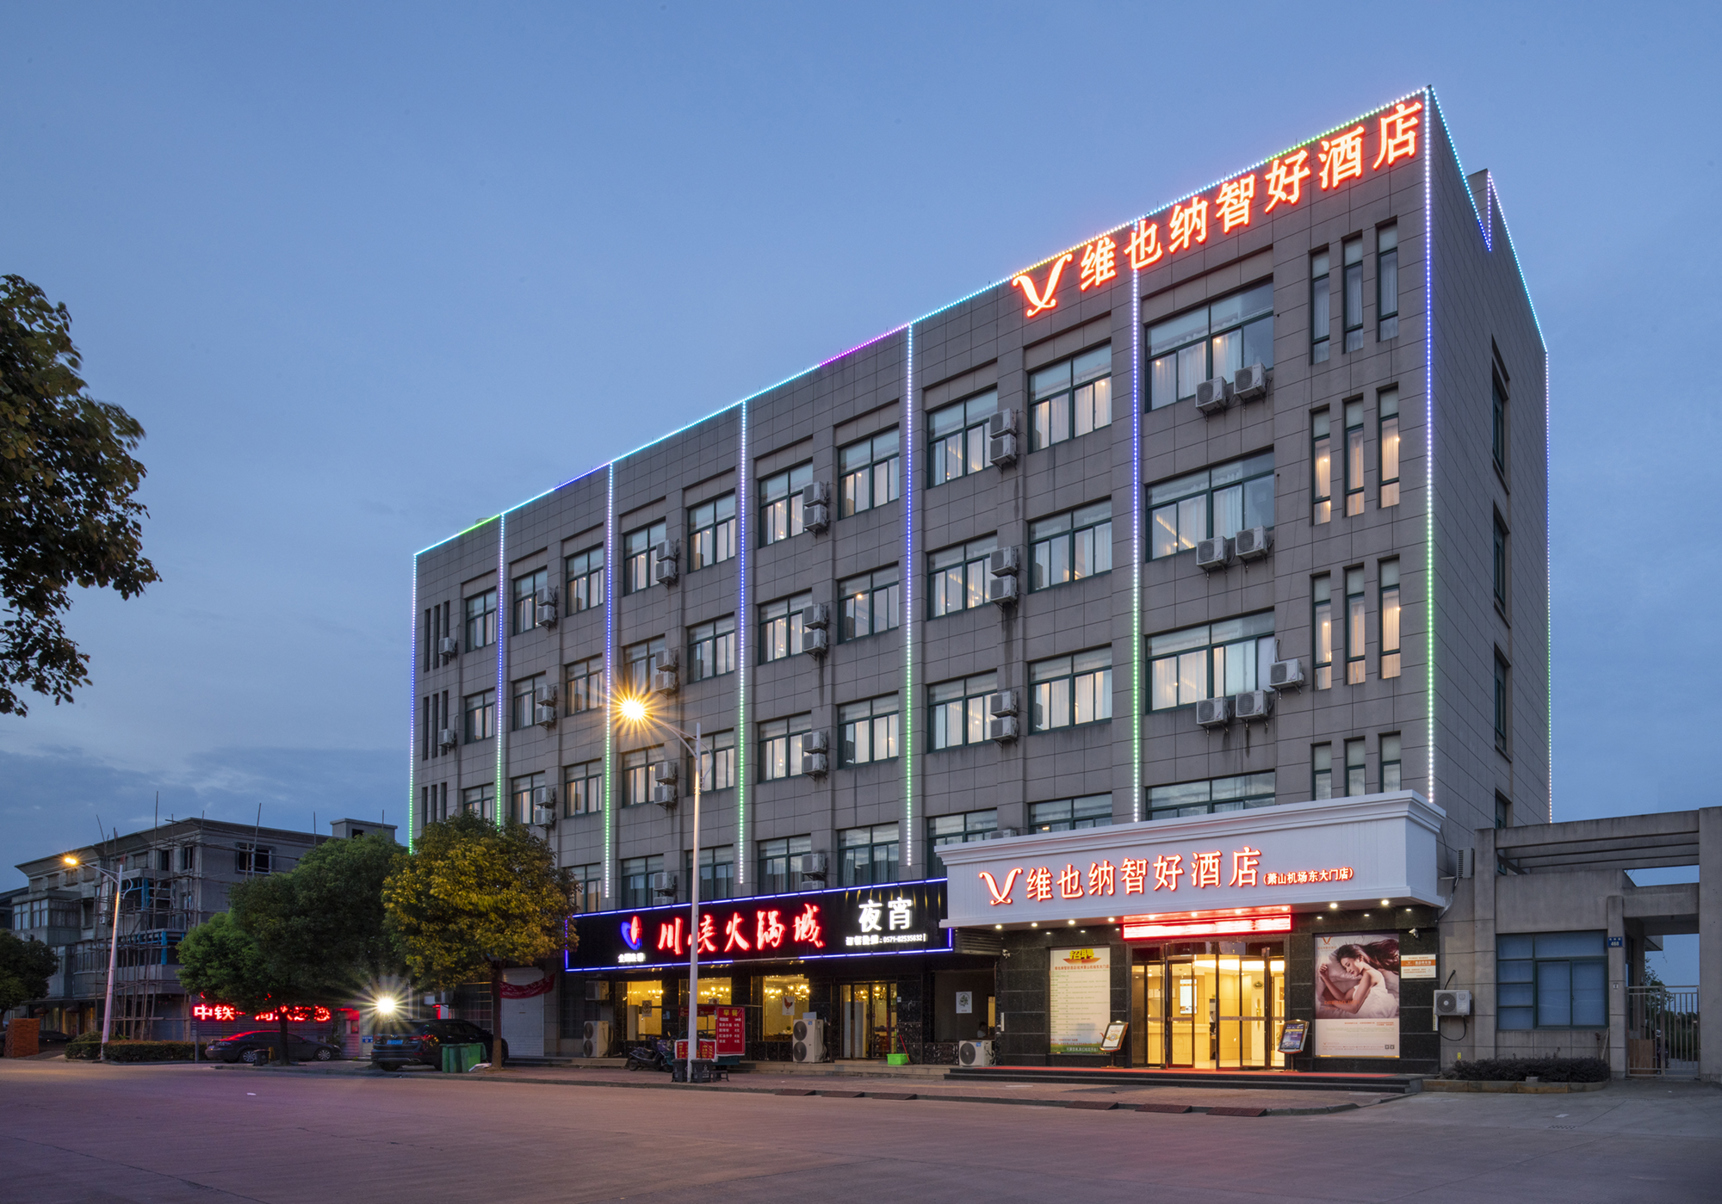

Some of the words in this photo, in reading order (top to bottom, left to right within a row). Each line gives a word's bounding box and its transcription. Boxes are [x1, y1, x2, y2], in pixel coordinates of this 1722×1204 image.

[1079, 100, 1423, 292] 维也纳智好酒店
[1025, 846, 1262, 902] 维也纳智好酒店
[858, 896, 913, 933] 夜宵
[1069, 948, 1095, 960] 招聘
